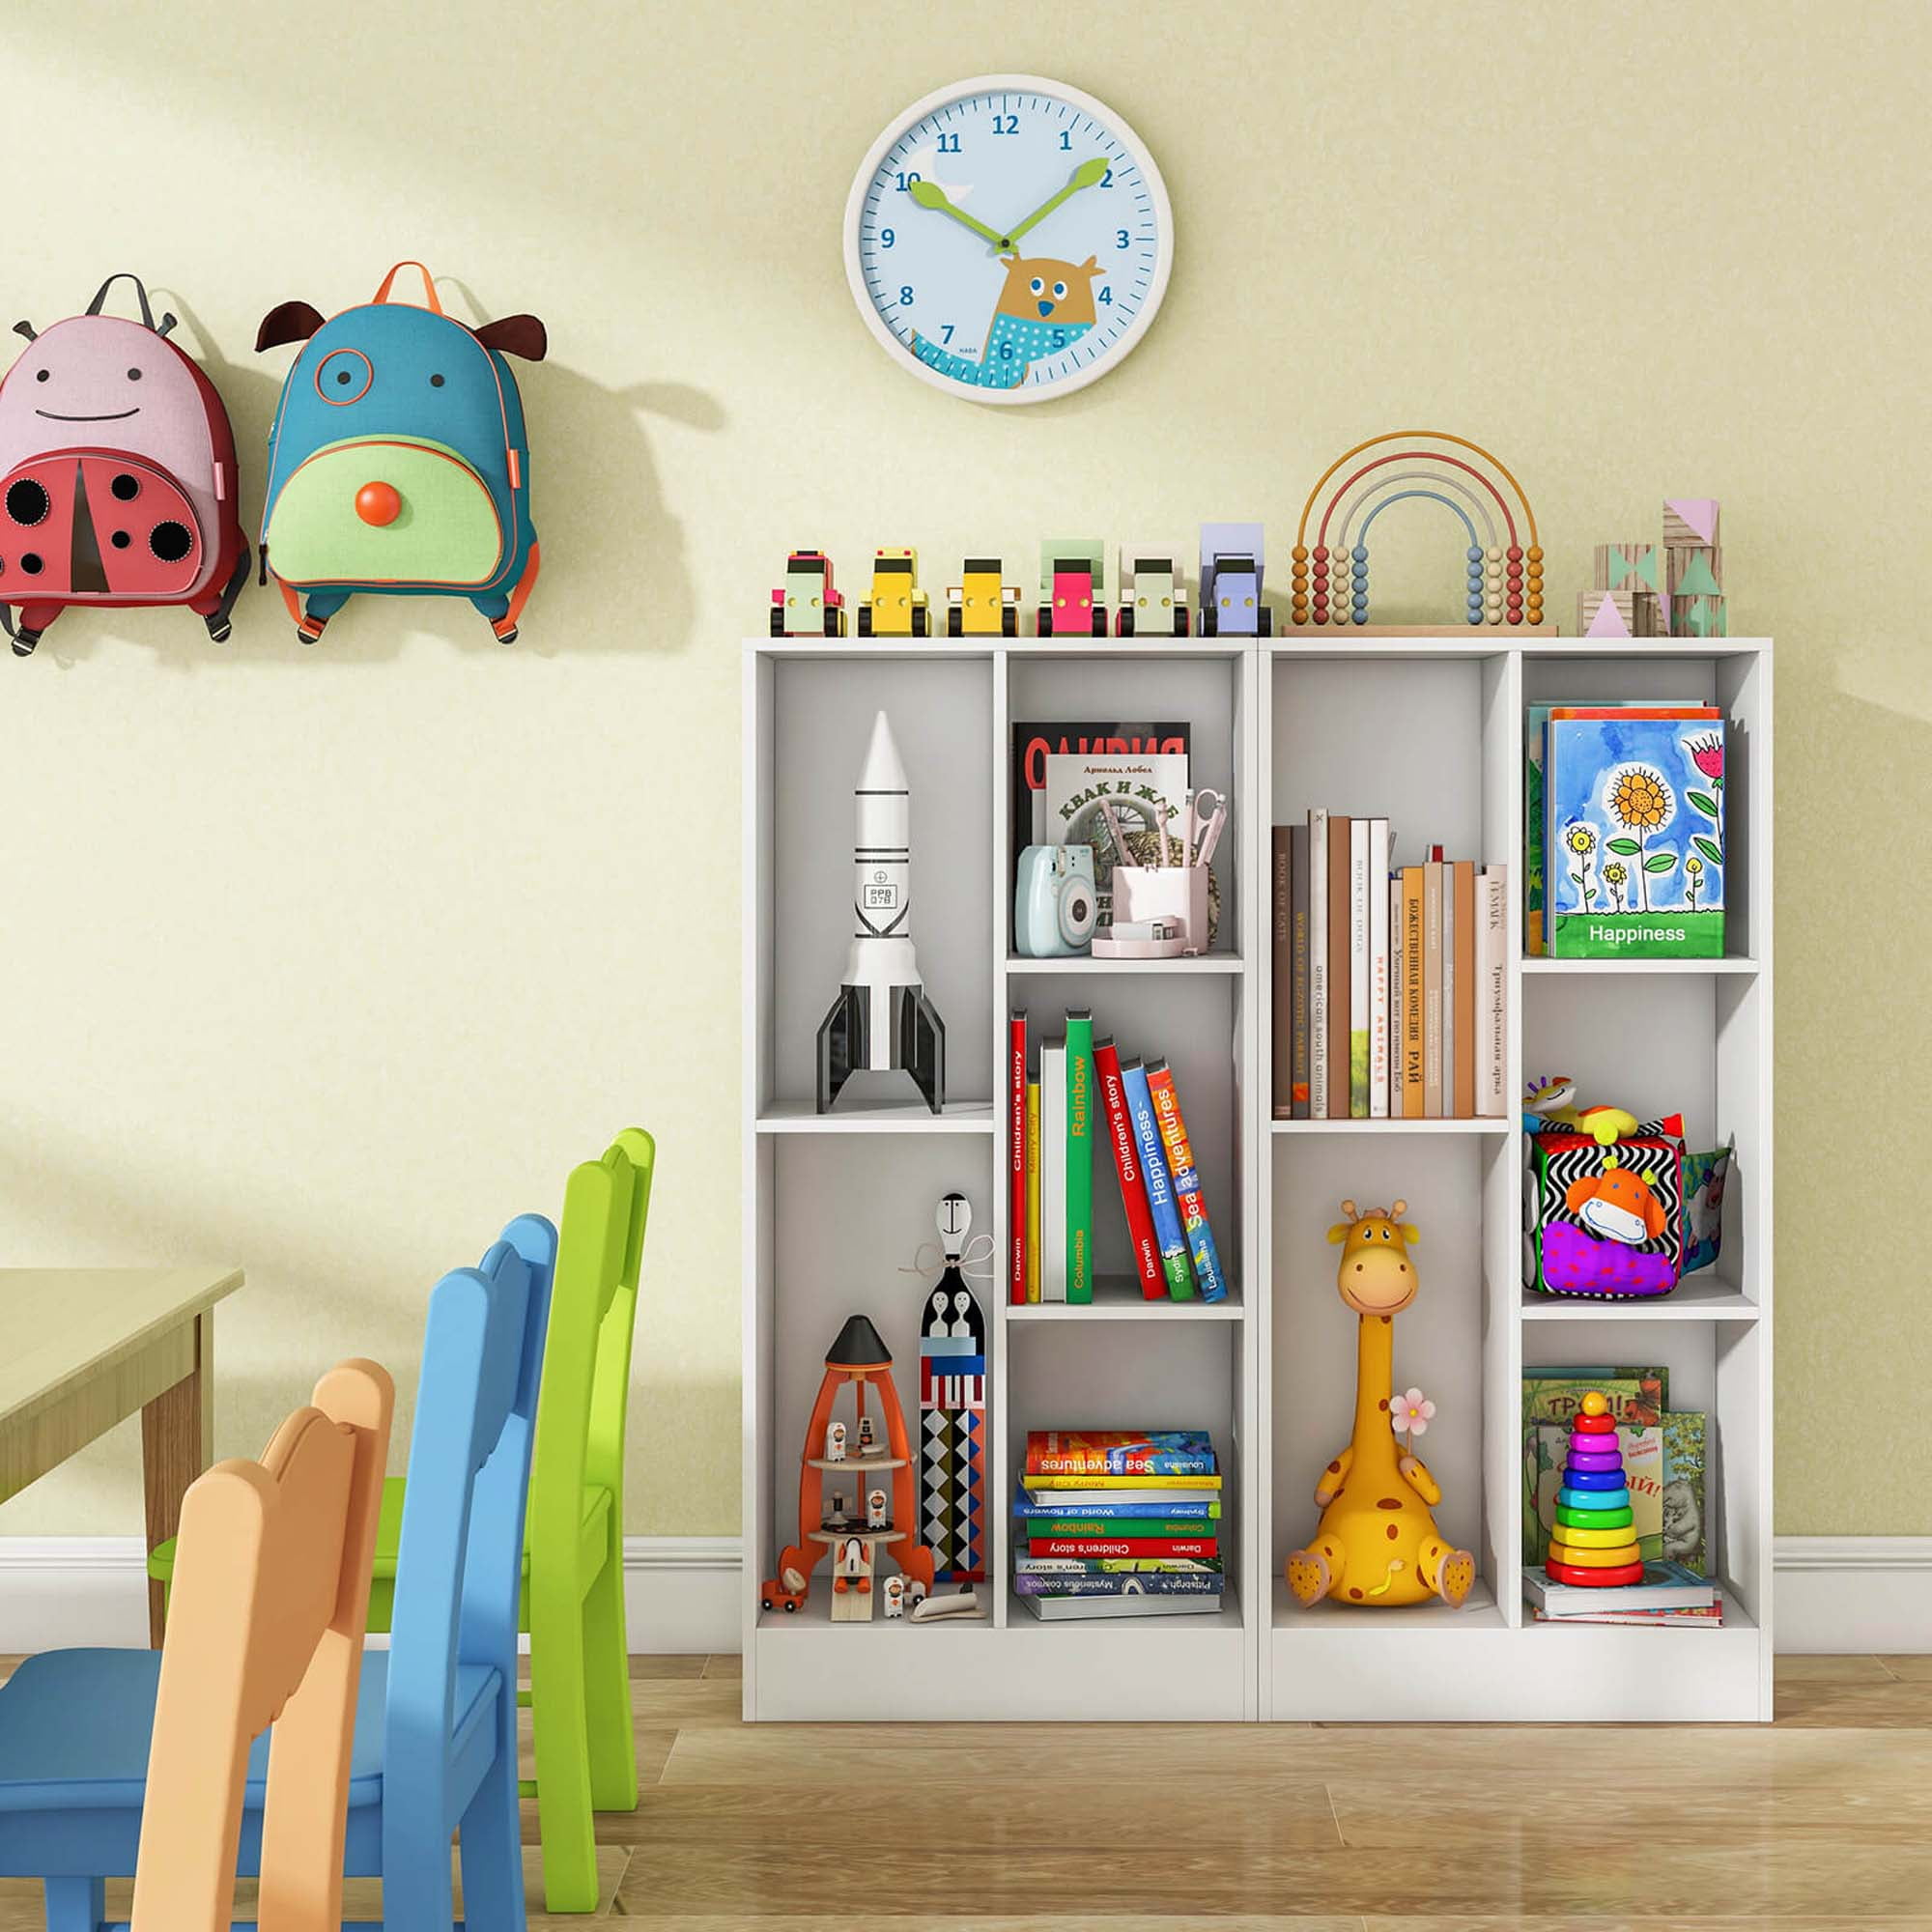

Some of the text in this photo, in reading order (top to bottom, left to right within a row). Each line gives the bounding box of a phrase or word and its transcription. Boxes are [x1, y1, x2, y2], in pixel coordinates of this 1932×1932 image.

[992, 115, 1019, 134] 12
[937, 133, 962, 153] 11
[1060, 131, 1072, 151] 1
[1100, 169, 1113, 188] 2
[881, 229, 895, 248] 9
[1116, 230, 1129, 249] 3
[900, 286, 914, 305] 8
[1097, 286, 1113, 305] 4
[941, 326, 954, 345] 7
[1053, 329, 1065, 348] 5
[1000, 341, 1013, 360] 6
[1059, 782, 1111, 820] КВАК
[1117, 781, 1131, 793] И
[1278, 853, 1287, 886] BOOK
[1589, 925, 1686, 943] Happiness
[1408, 898, 1423, 1083] БОЖЕСТВЕННАЯ КОМЕДИЯ РАЙ
[1316, 966, 1326, 1113] american south animals
[1071, 1056, 1086, 1137] Rainbow
[1105, 1074, 1135, 1181] Children's story
[1138, 1110, 1167, 1206] Happiness
[1159, 1089, 1203, 1232] Sea adventures
[1073, 1230, 1084, 1289] Columbia
[1142, 1239, 1155, 1278] Darwin
[1200, 1240, 1217, 1290] Louisiana
[1041, 1460, 1155, 1470] Sea adventures
[1051, 1523, 1105, 1534] Rainbow
[1050, 1543, 1129, 1554] Children's story
